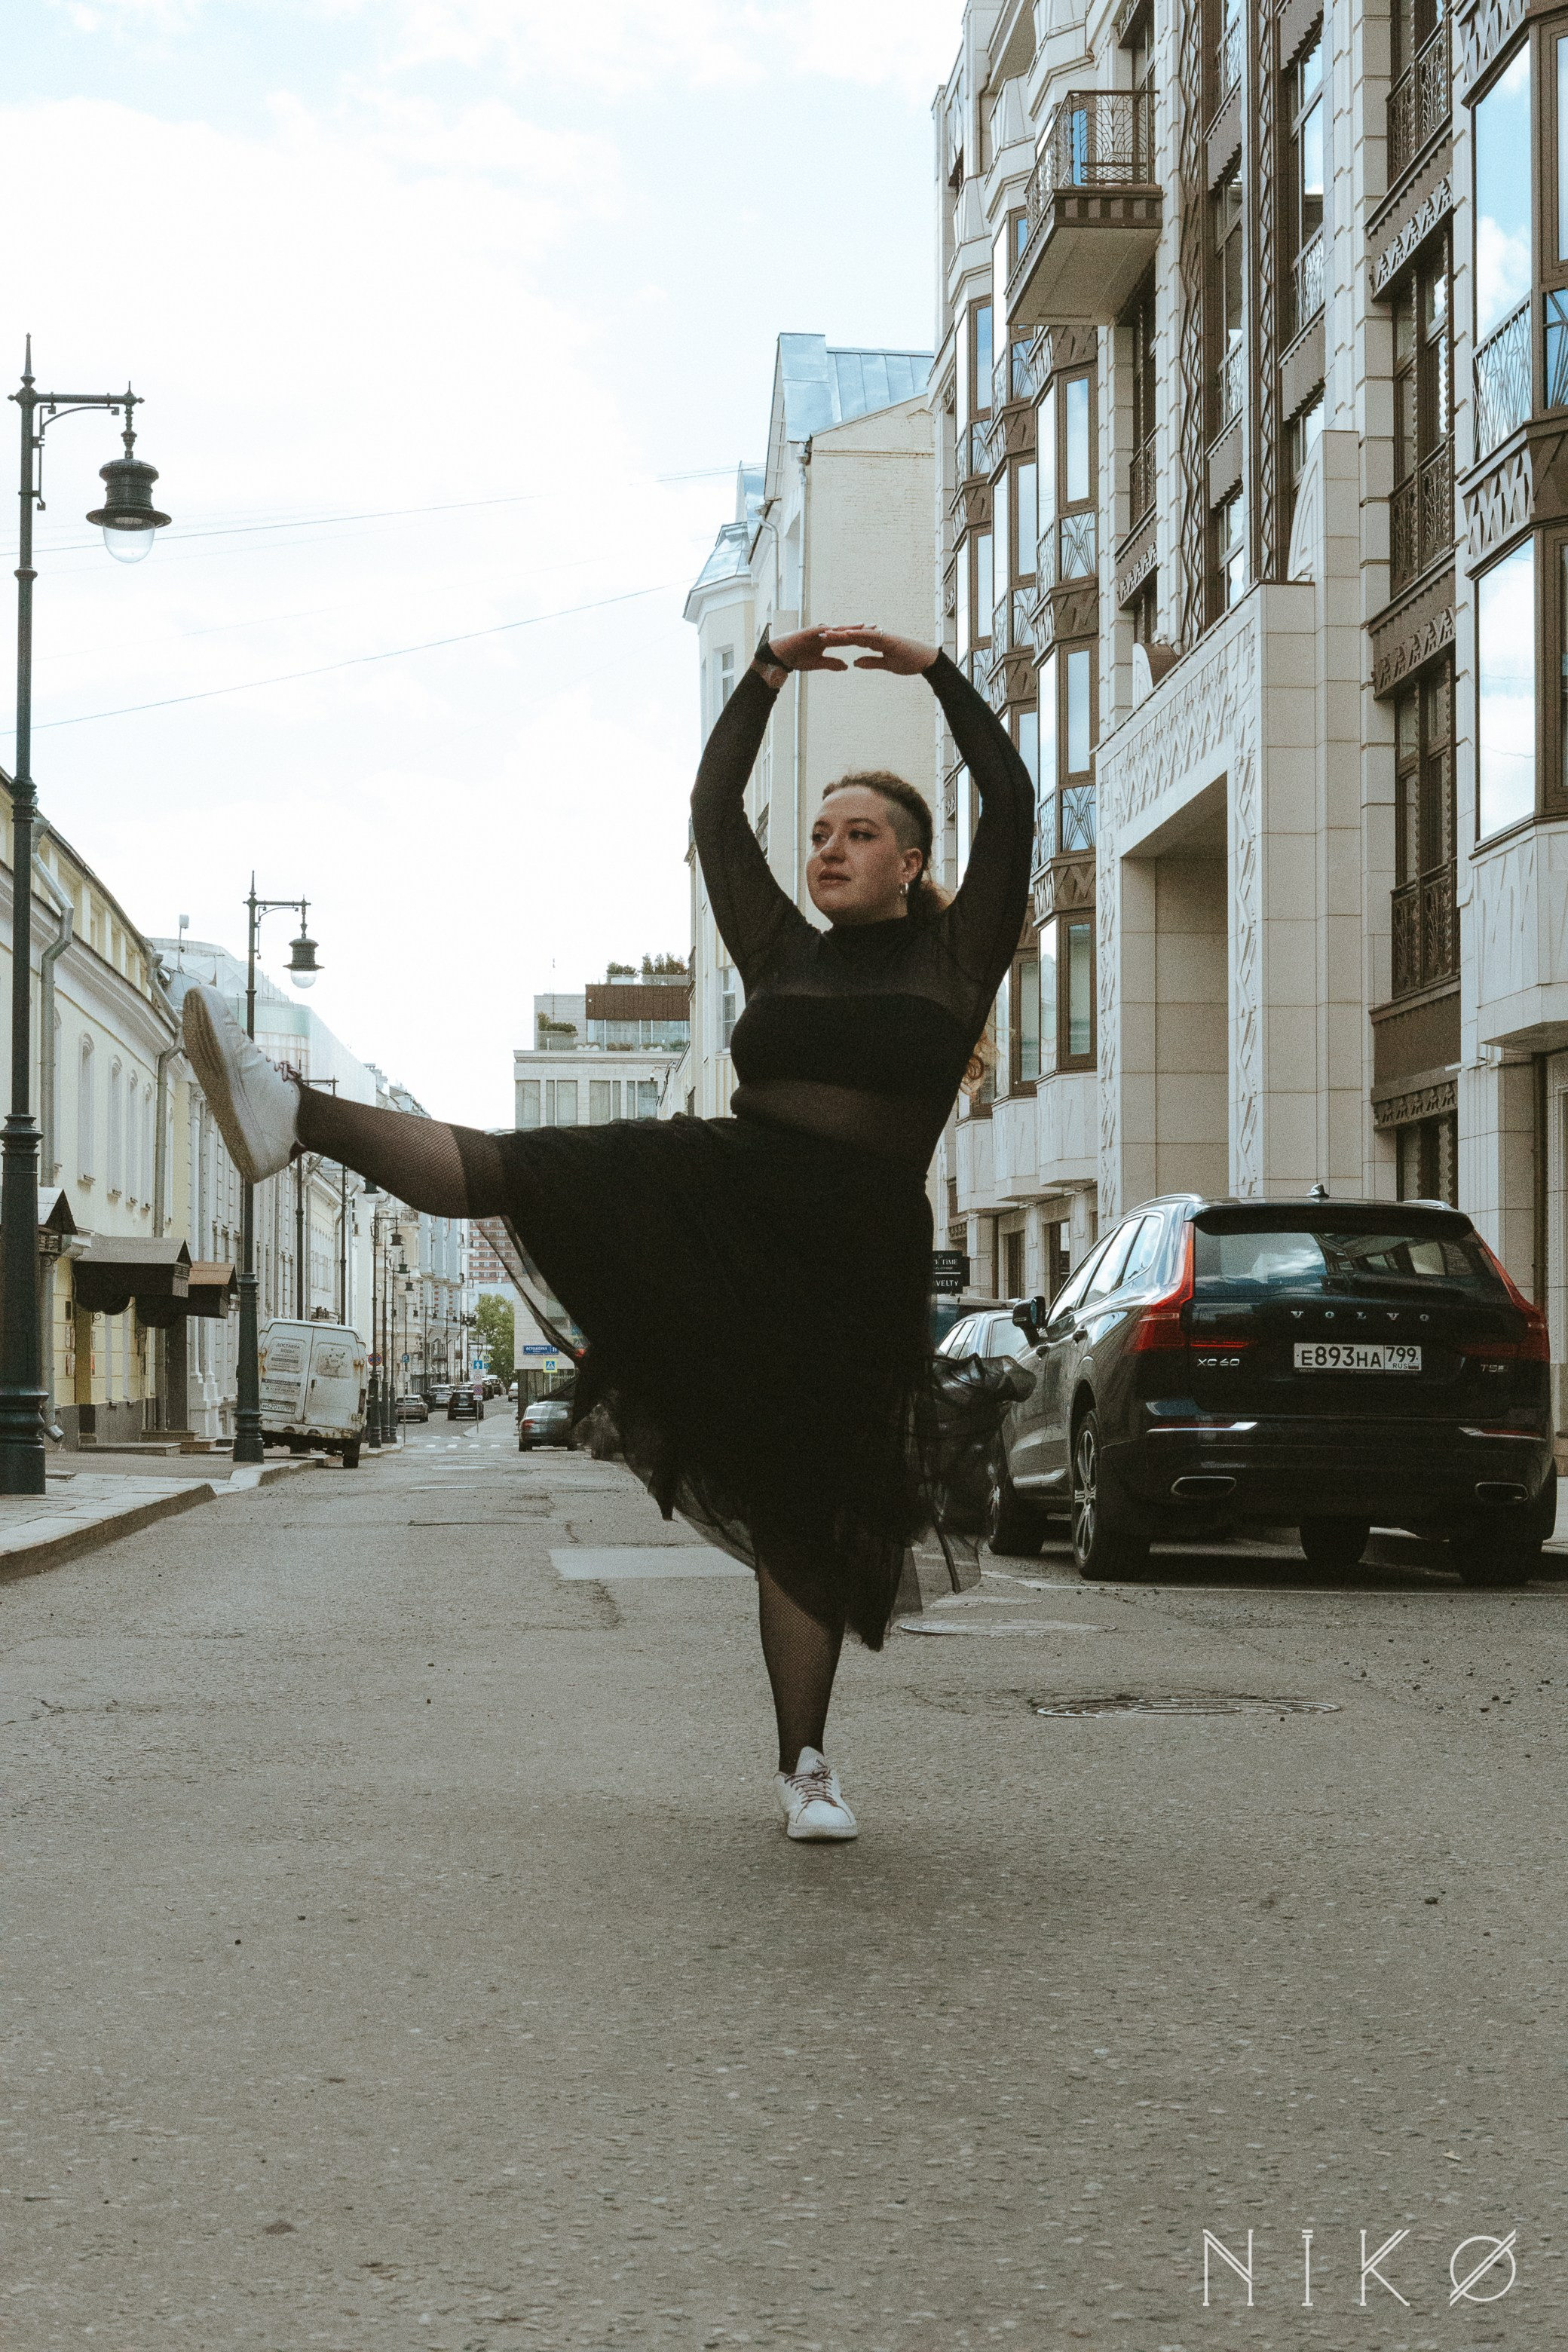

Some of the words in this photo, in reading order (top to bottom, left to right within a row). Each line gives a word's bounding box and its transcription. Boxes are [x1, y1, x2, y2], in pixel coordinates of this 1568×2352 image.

[1291, 1310, 1429, 1321] VOLVO
[1386, 1346, 1417, 1363] 799
[1197, 1358, 1240, 1367] XC60
